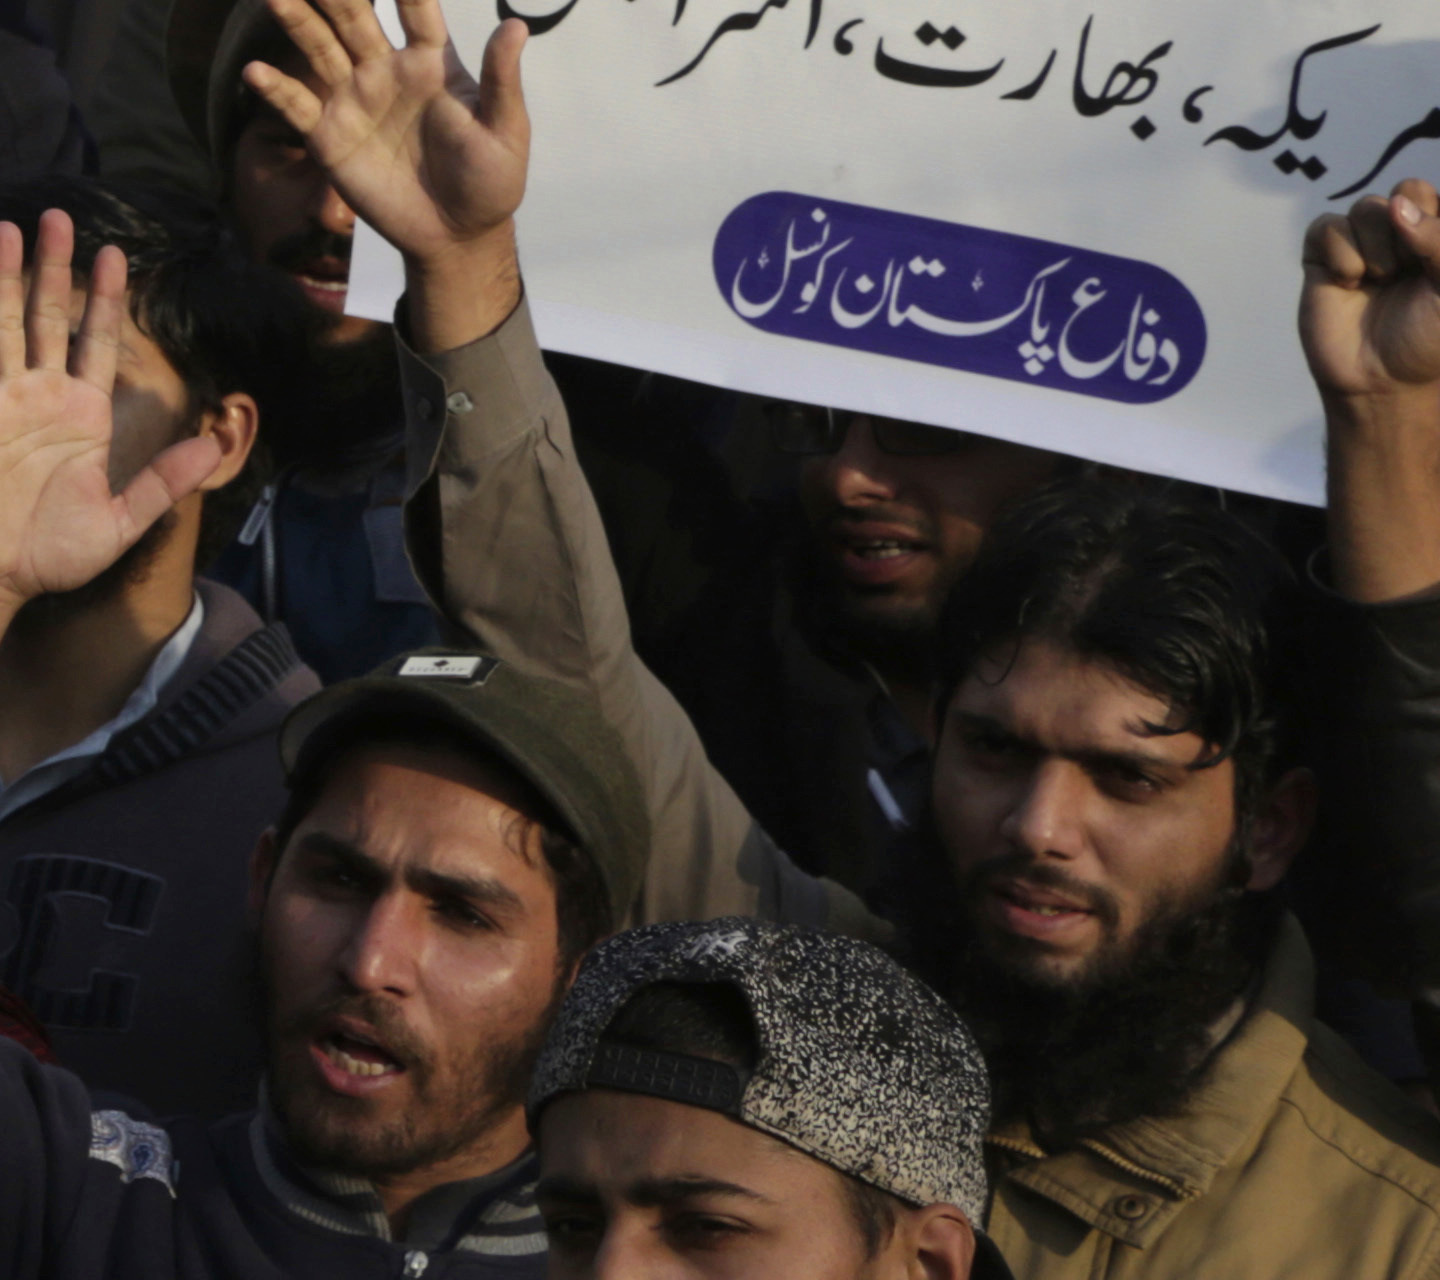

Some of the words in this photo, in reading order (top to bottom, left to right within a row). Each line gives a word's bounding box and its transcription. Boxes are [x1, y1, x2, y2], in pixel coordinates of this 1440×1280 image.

[728, 205, 864, 317] کونسل
[830, 252, 1076, 377] پاکستان
[1054, 268, 1182, 385] دفاع
